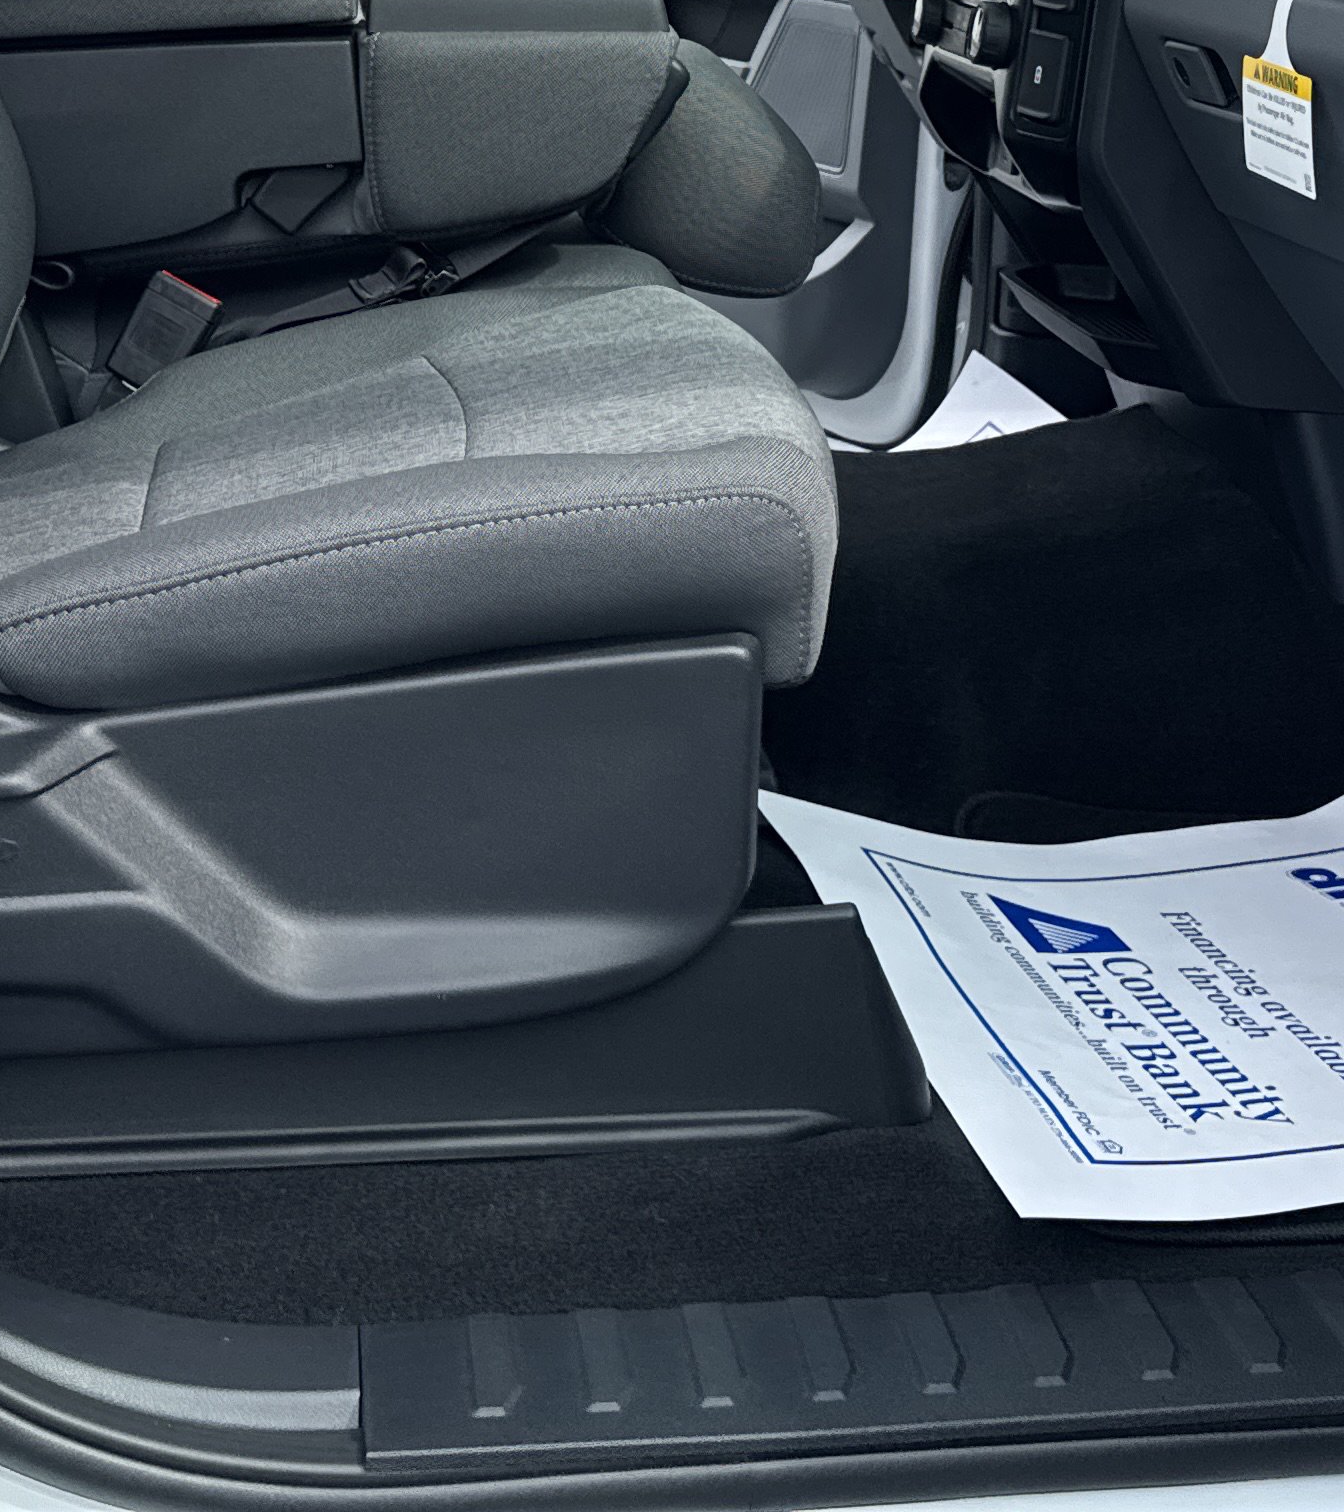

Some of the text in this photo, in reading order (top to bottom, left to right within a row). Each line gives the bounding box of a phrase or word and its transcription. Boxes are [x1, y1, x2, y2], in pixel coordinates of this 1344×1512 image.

[1262, 63, 1299, 95] WARNING
[960, 890, 1004, 944] building
[1118, 1074, 1144, 1093] on
[1159, 910, 1271, 998] Financing
[1102, 956, 1295, 1125] Community
[1177, 965, 1278, 1039] through
[1120, 1040, 1232, 1124] Bank
